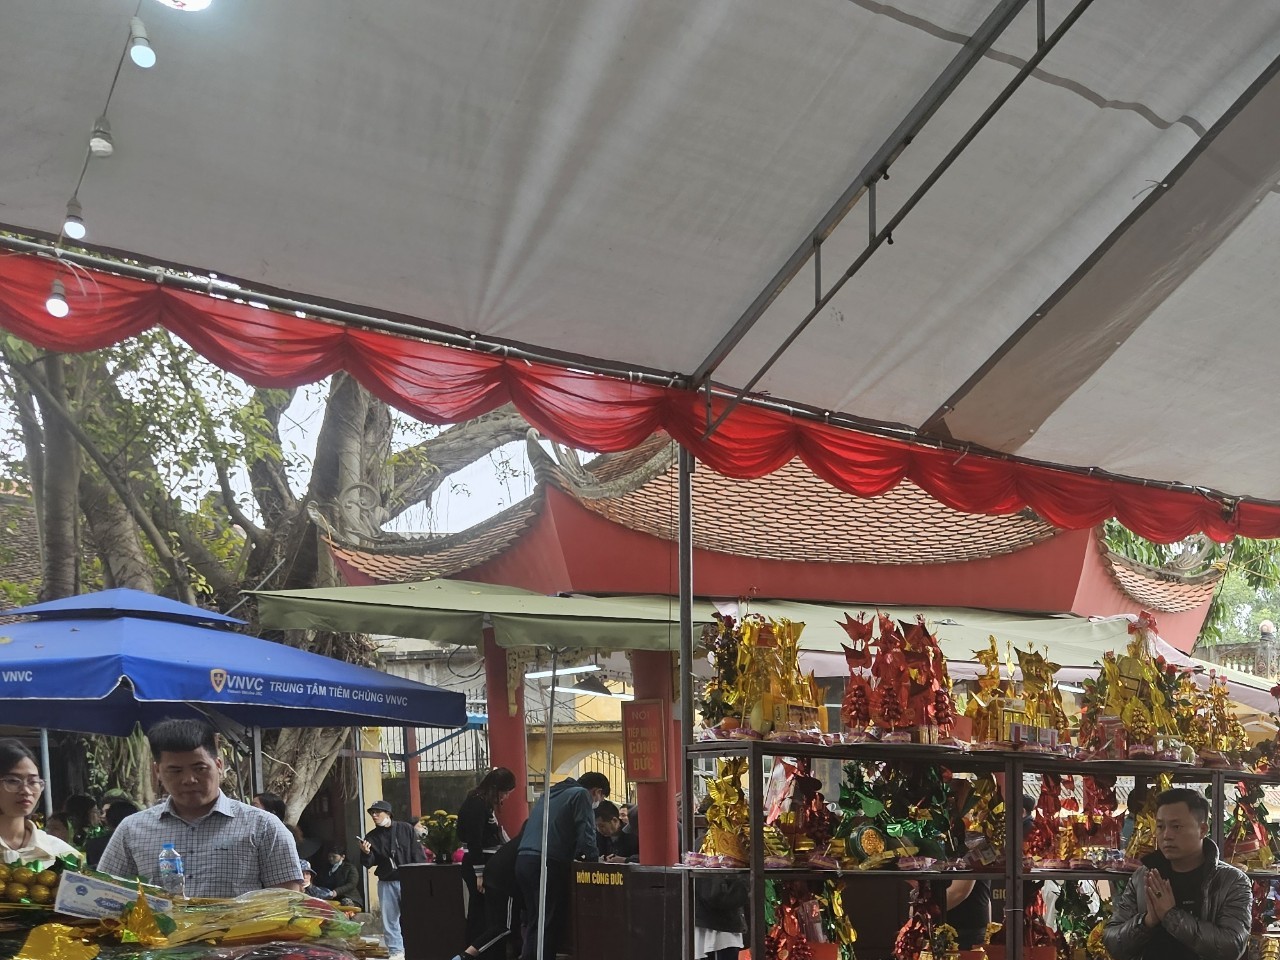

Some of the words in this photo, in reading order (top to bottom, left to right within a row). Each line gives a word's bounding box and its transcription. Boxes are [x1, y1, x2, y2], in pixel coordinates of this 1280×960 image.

[2, 671, 33, 682] VNVC
[227, 675, 264, 691] VNVC
[269, 681, 304, 694] TRUNG
[306, 684, 327, 696] TÂM
[329, 685, 350, 699] TIÊM
[385, 694, 408, 707] VNVC
[629, 739, 657, 754] CÔNG
[592, 870, 610, 885] CÔNG
